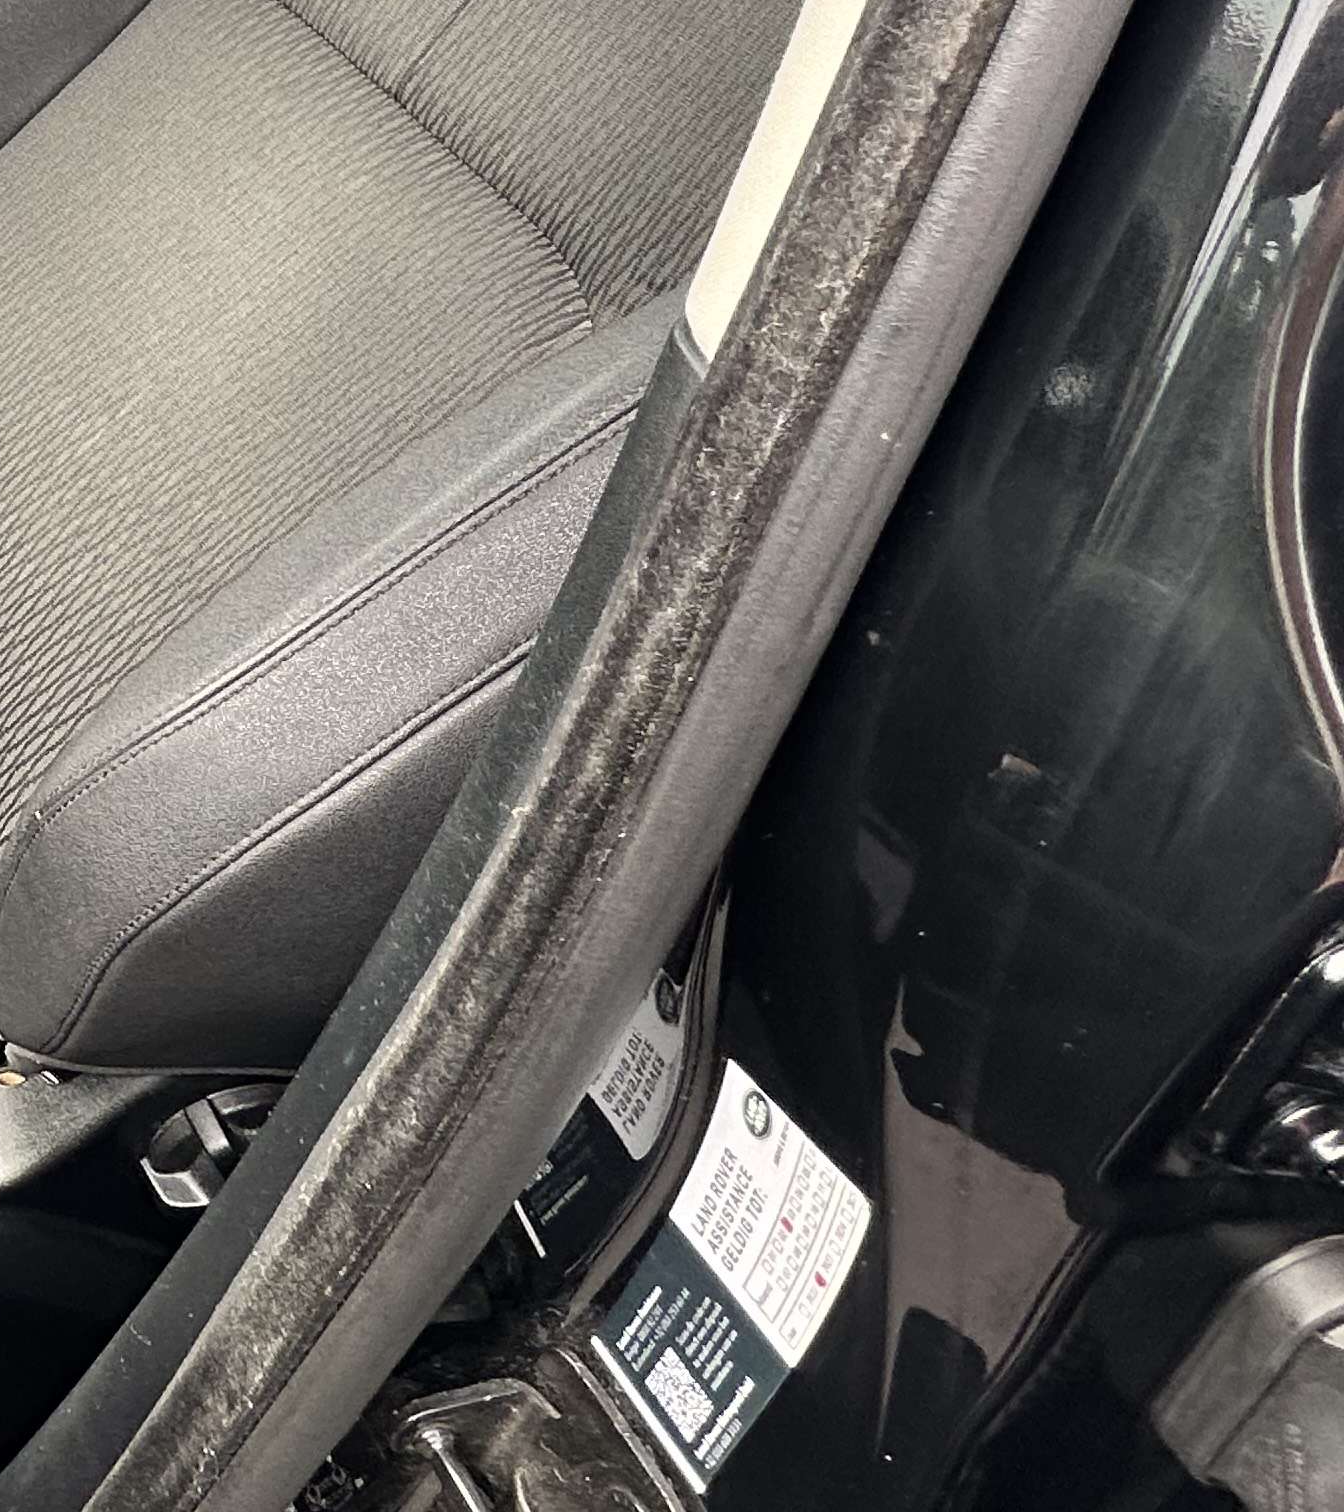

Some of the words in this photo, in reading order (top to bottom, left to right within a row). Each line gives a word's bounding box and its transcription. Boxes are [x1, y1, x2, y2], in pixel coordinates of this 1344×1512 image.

[691, 1194, 717, 1237] LAND
[710, 1147, 738, 1196] ROVER
[706, 1165, 754, 1255] ASSISTANCE
[720, 1217, 754, 1272] GELDIG
